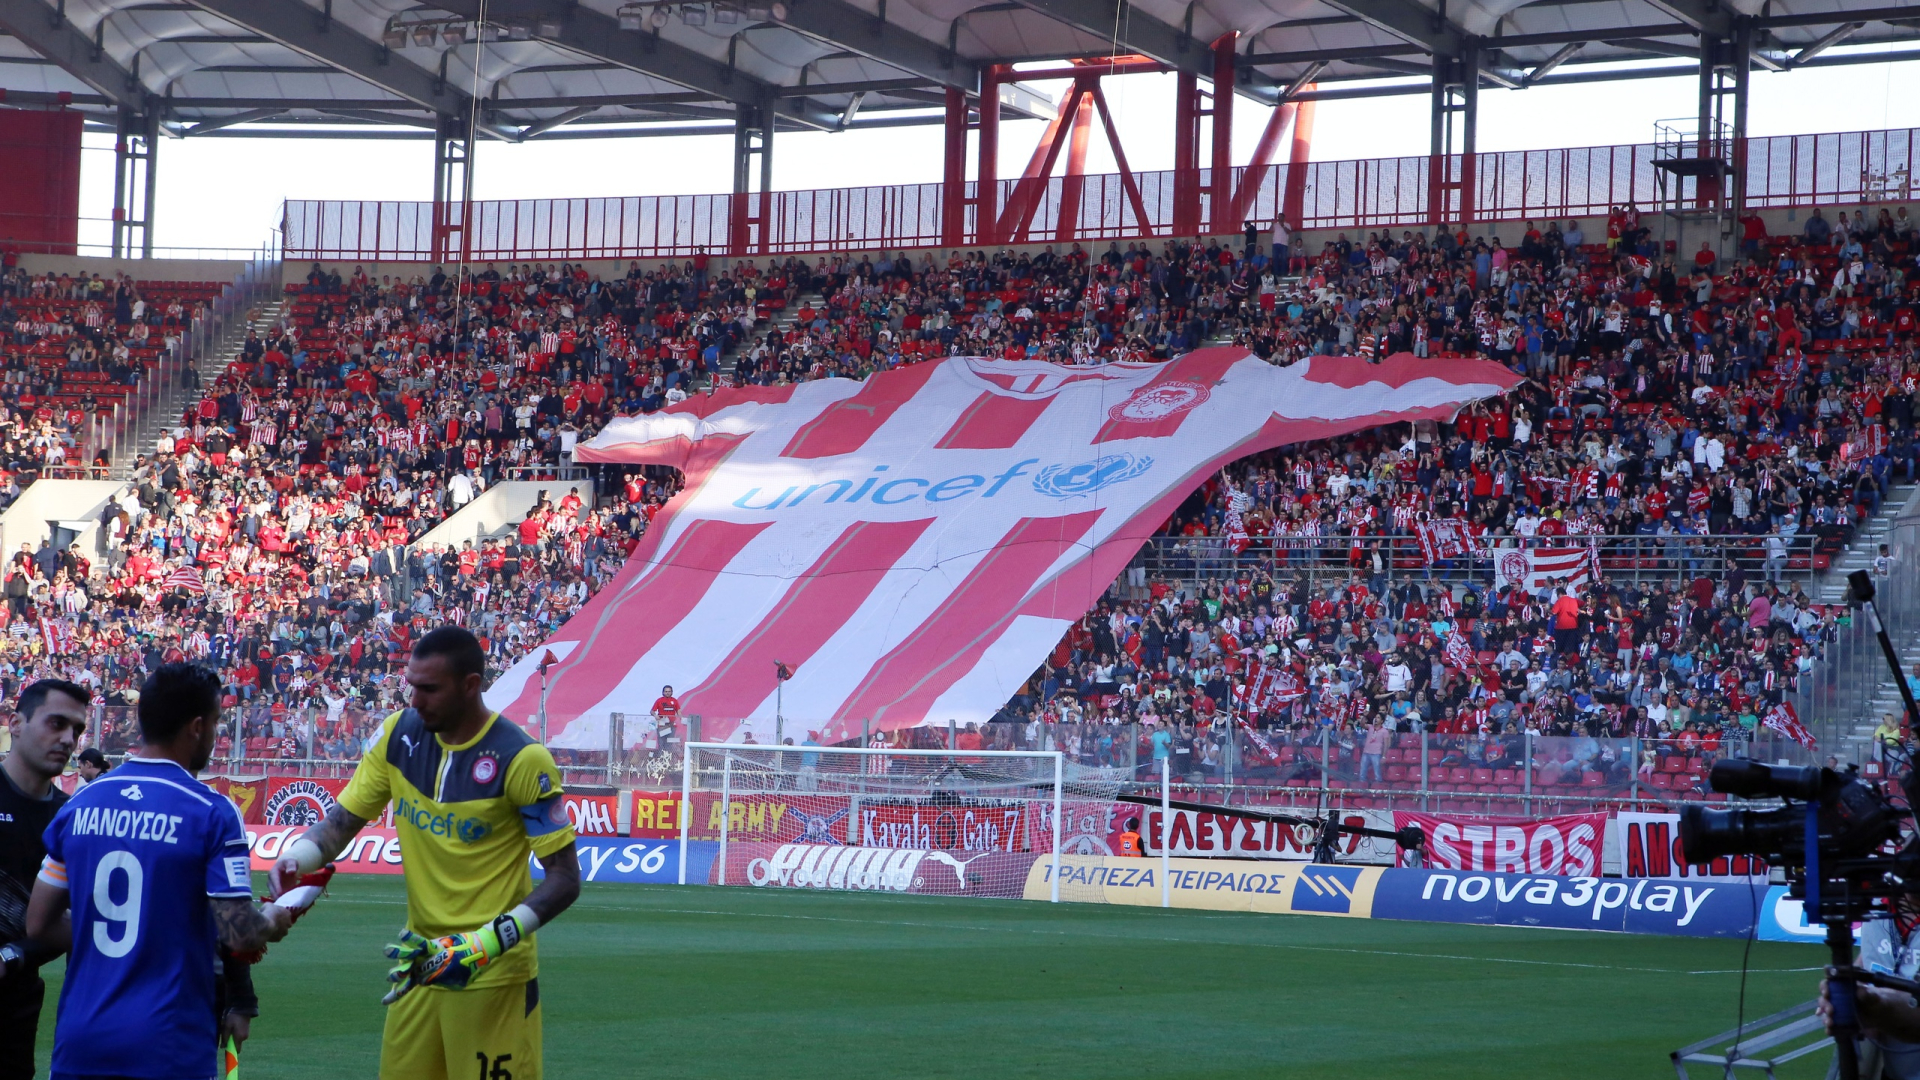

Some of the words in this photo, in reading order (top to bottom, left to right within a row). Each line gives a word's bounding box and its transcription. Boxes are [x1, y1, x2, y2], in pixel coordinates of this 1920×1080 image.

[732, 458, 1040, 510] unicef
[637, 799, 694, 830] RED
[708, 801, 788, 834] ARMY
[863, 810, 931, 850] Kavala
[963, 810, 999, 851] Gate
[1004, 810, 1020, 852] 7
[615, 843, 668, 875] S6
[93, 850, 144, 958] 9
[1421, 873, 1716, 927] nova3play
